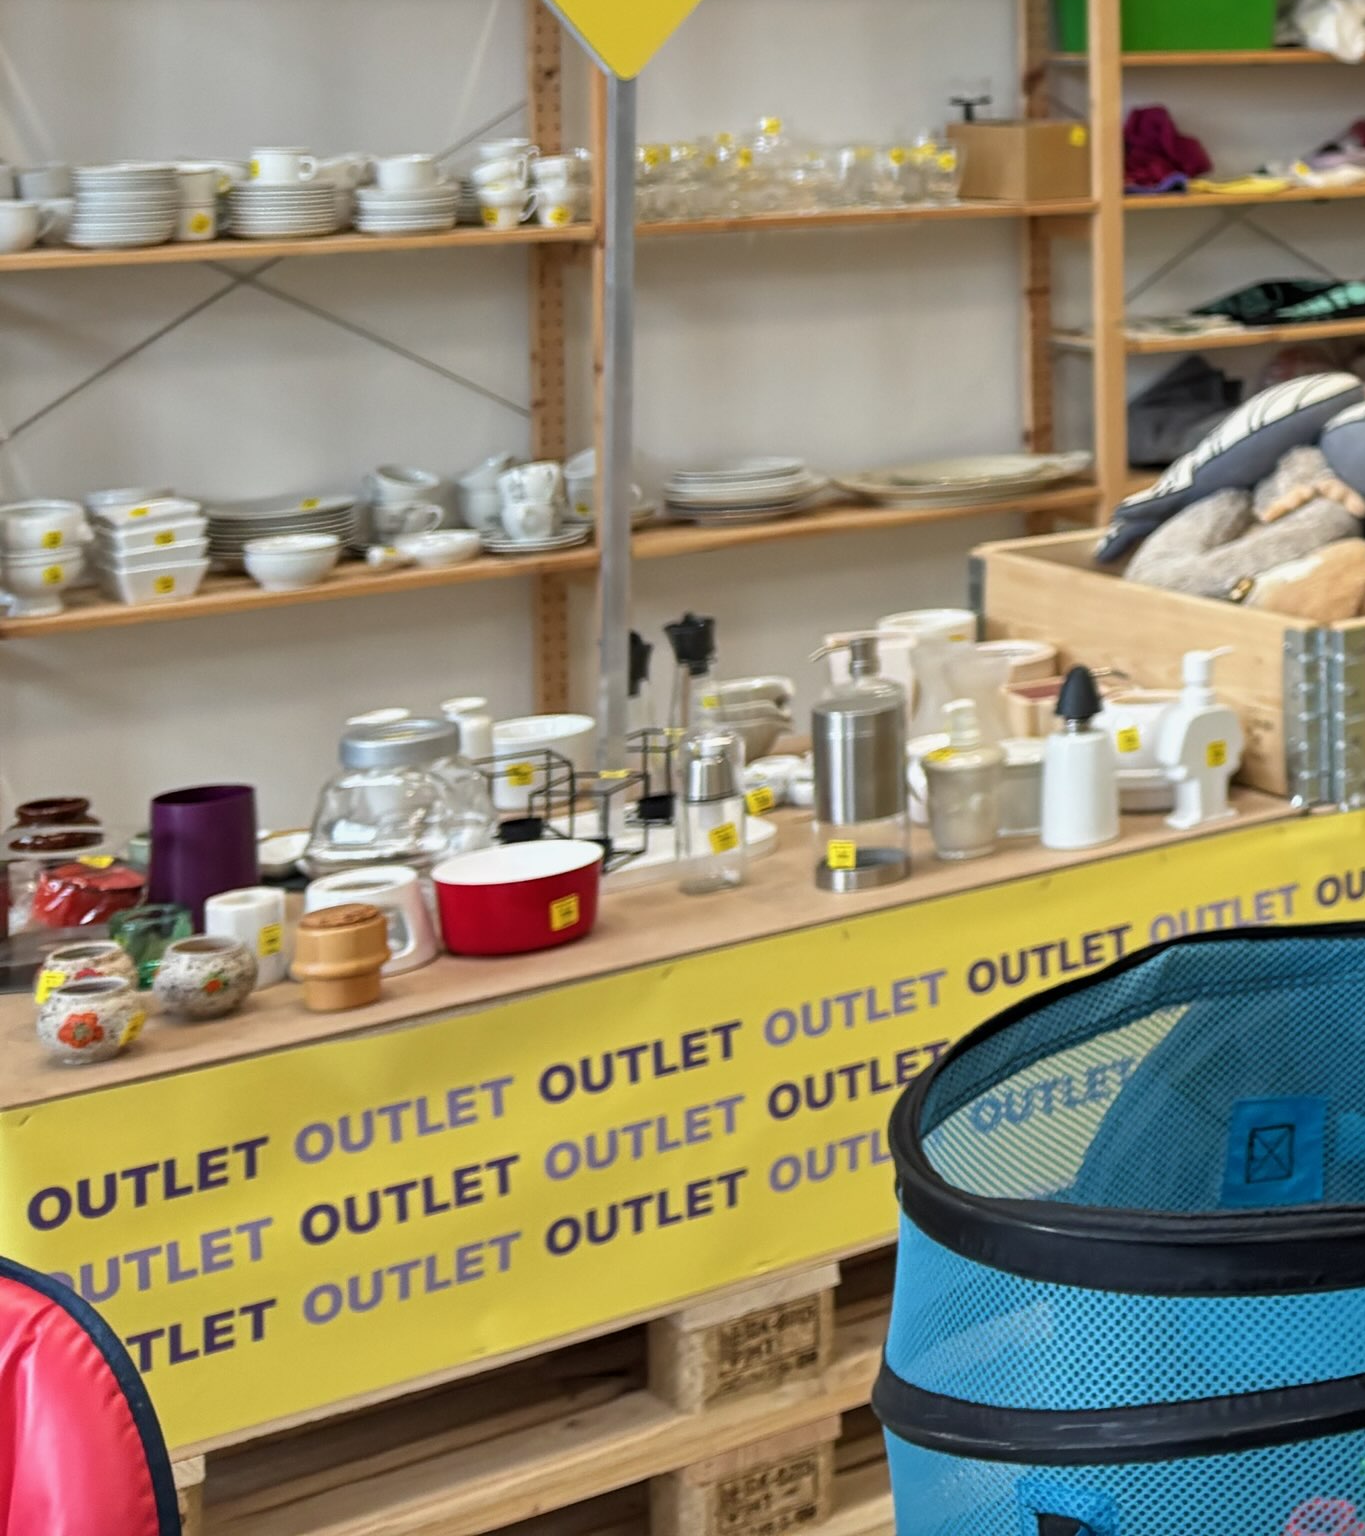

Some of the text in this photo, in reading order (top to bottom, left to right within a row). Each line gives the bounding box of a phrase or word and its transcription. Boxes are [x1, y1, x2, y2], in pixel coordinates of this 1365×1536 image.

[27, 1135, 270, 1232] OUTLET
[294, 1075, 514, 1165] OUTLET
[539, 1020, 742, 1104] OUTLET
[764, 969, 948, 1048] OUTLET
[967, 923, 1133, 995] OUTLET
[1150, 882, 1299, 948] OUTLET
[300, 1154, 520, 1246] OUTLET
[545, 1093, 745, 1182] OUTLET
[768, 1038, 949, 1120] OUTLET
[122, 1297, 278, 1375] TLET
[302, 1230, 522, 1326] OUTLET
[546, 1167, 748, 1257] OUTLET
[768, 1128, 892, 1195] OUTL
